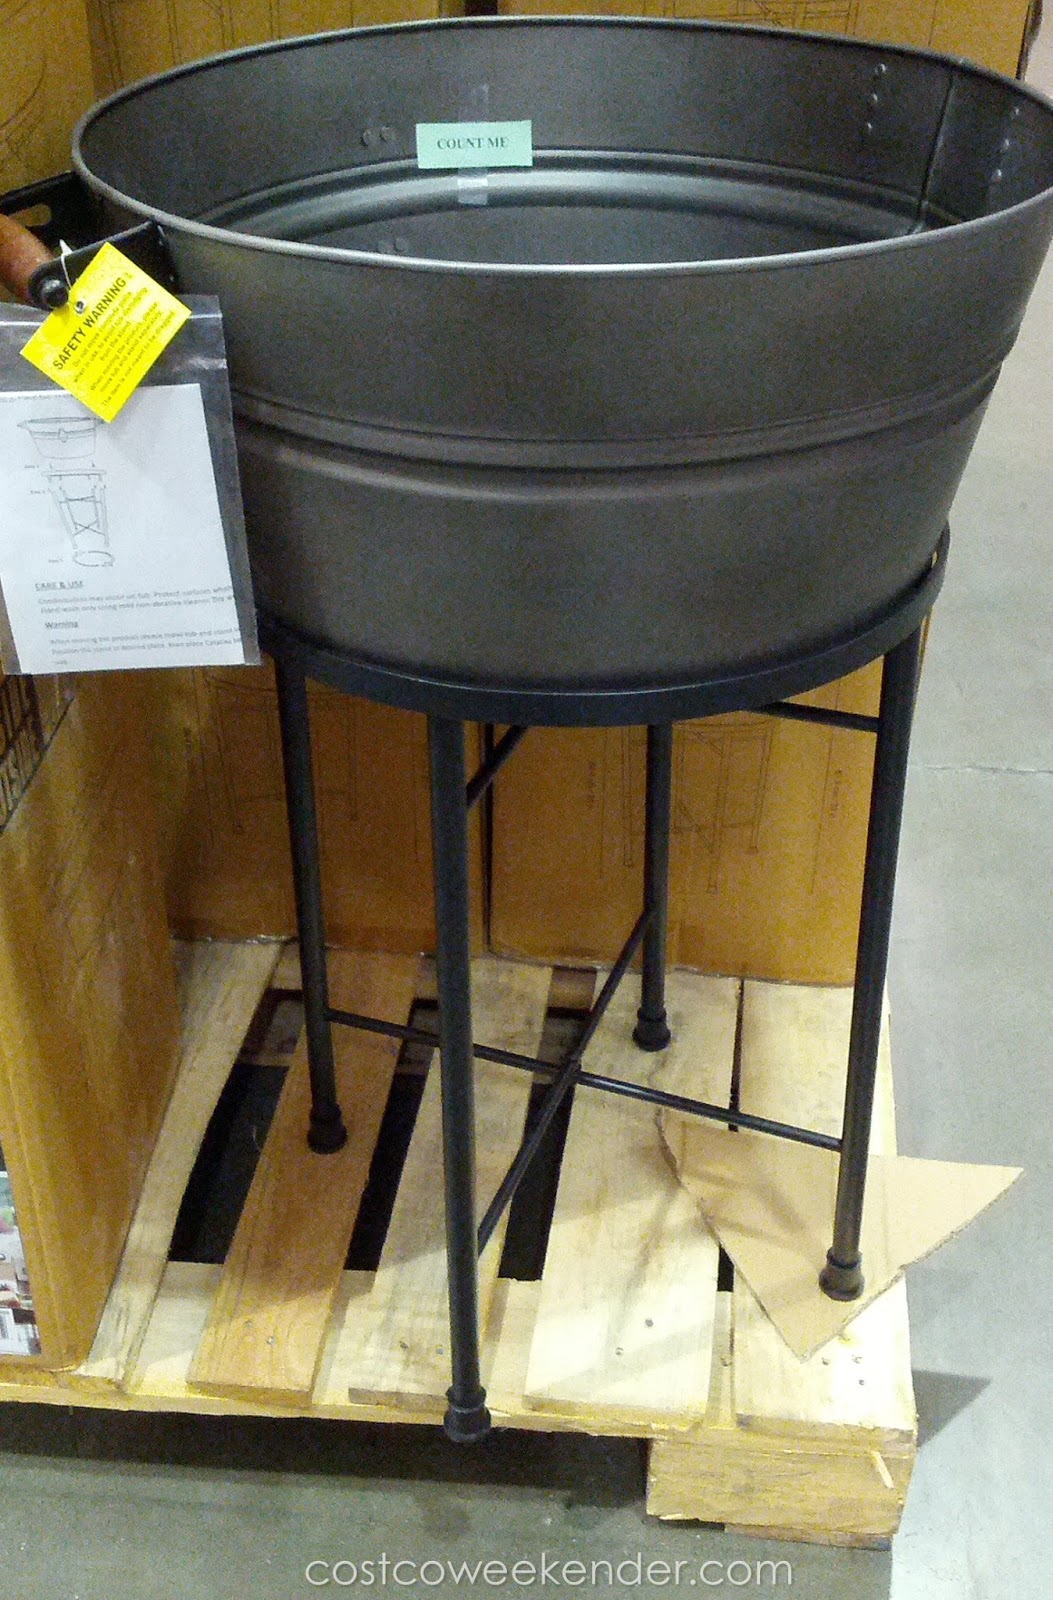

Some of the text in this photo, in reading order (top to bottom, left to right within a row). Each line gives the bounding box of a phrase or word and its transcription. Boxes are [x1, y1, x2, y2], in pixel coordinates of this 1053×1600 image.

[436, 136, 509, 150] COUNT ME
[51, 326, 88, 370] SAFETY
[82, 275, 127, 330] WARNING
[86, 331, 100, 348] move
[109, 337, 118, 348] the
[116, 343, 126, 354] the
[117, 354, 128, 367] and
[35, 582, 58, 591] CARE
[67, 580, 84, 589] USE
